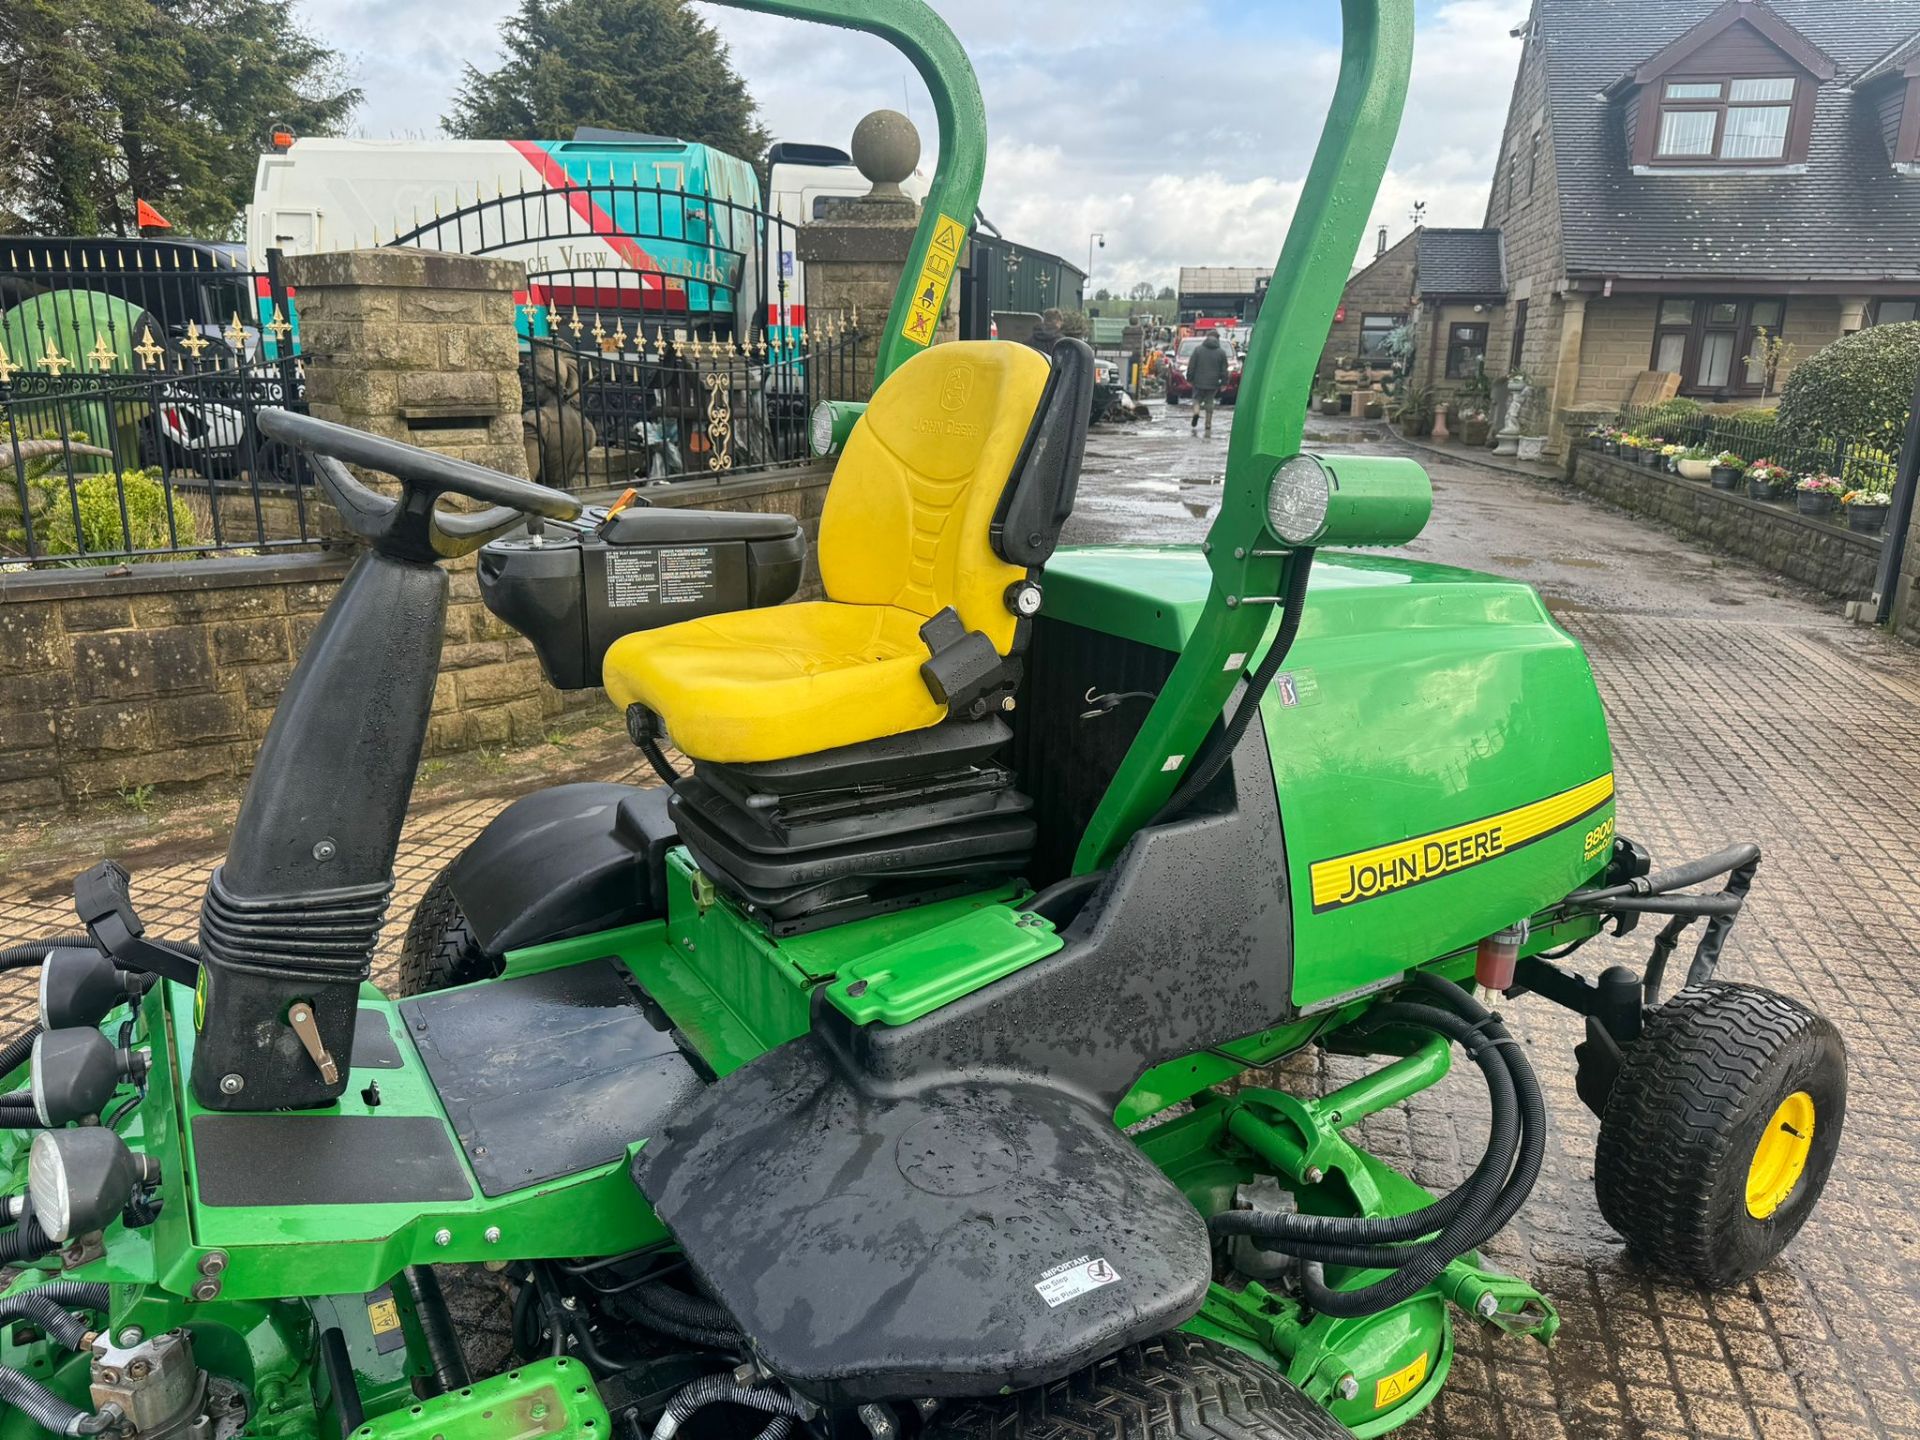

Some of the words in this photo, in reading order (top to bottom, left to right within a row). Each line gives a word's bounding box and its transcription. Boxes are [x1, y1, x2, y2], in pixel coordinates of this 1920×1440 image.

[558, 245, 608, 269] VIEW
[620, 242, 723, 284] NURSERIES
[1585, 817, 1613, 850] 8800
[1340, 853, 1417, 900] JOHN
[1424, 827, 1503, 873] DEERE
[1041, 1255, 1090, 1279] IMPORTANT
[1040, 1284, 1051, 1292] No
[1048, 1297, 1060, 1305] No
